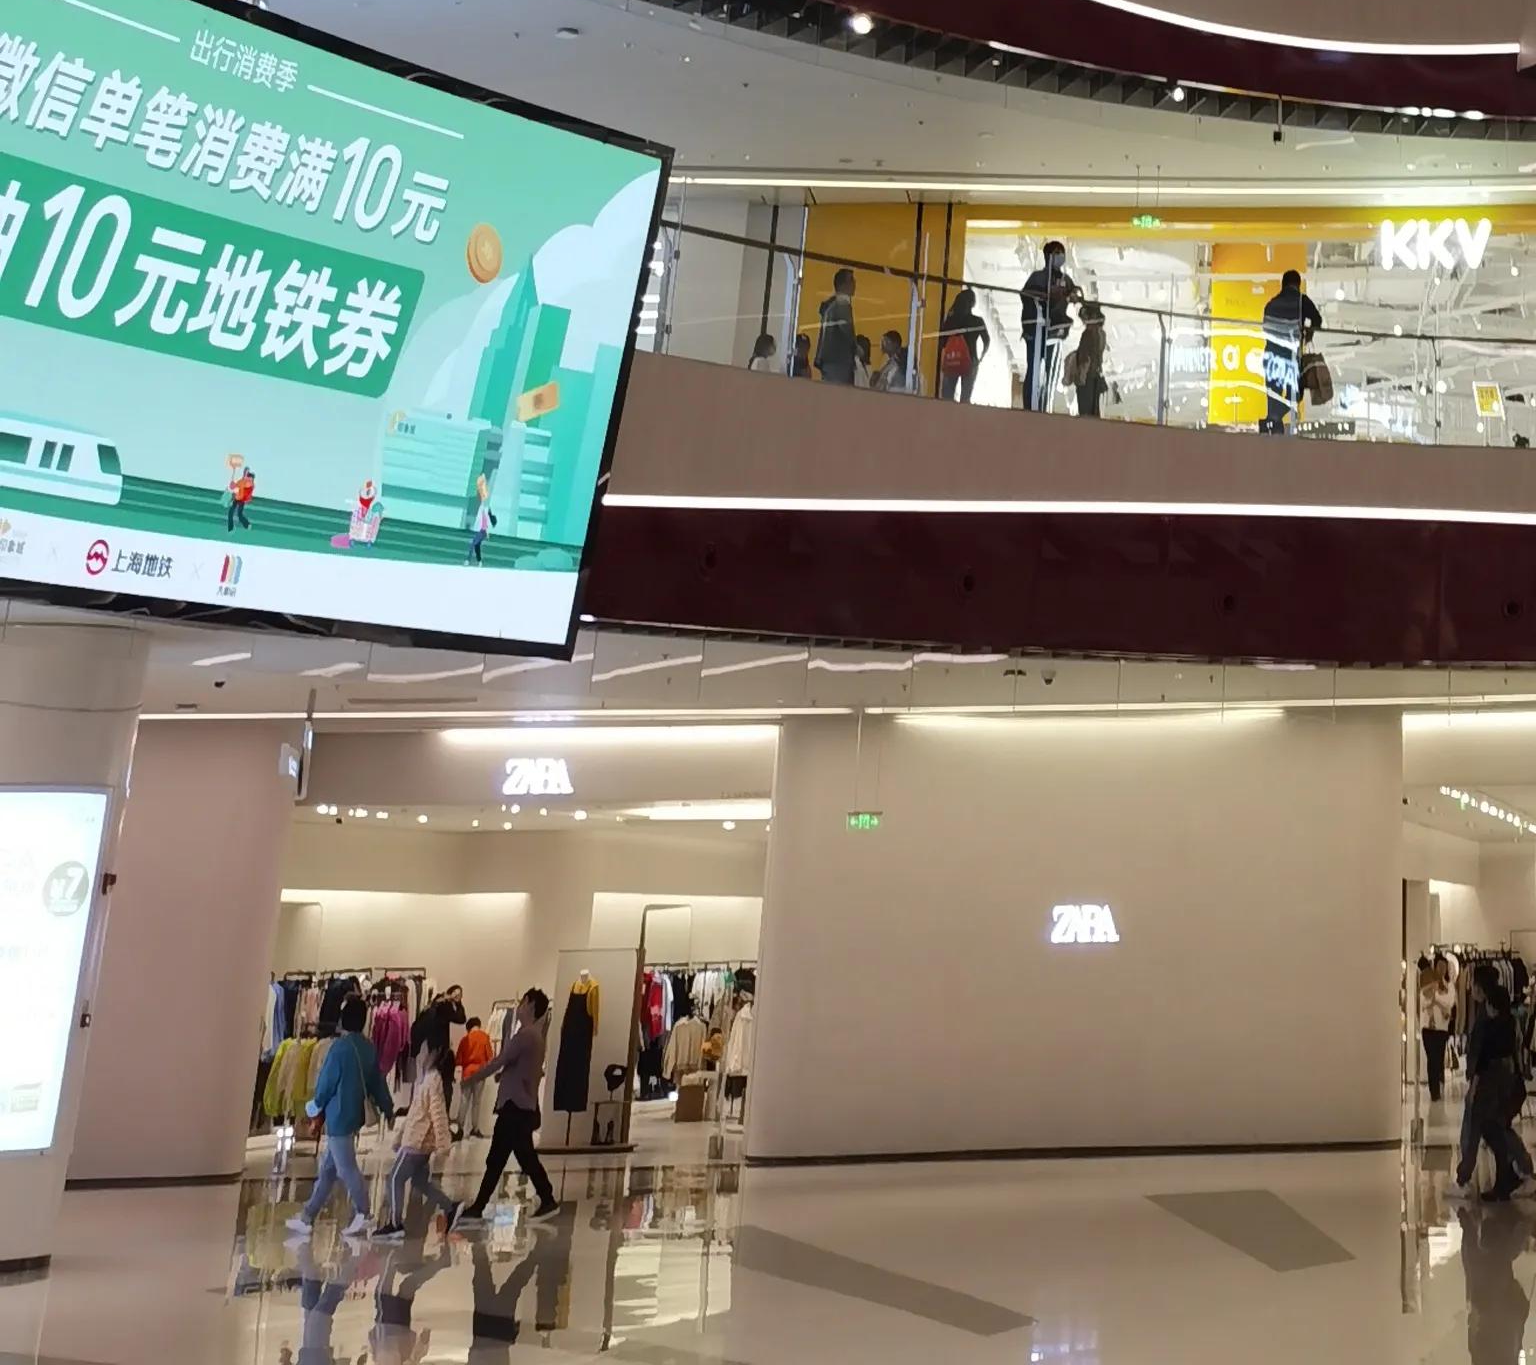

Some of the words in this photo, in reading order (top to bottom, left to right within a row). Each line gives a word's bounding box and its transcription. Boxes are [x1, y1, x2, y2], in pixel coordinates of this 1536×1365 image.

[189, 28, 300, 94] 出行消费季
[1381, 217, 1493, 271] KKV
[111, 548, 174, 579] 上海地铁
[502, 757, 575, 795] ZARA
[1050, 904, 1120, 944] ZARA
